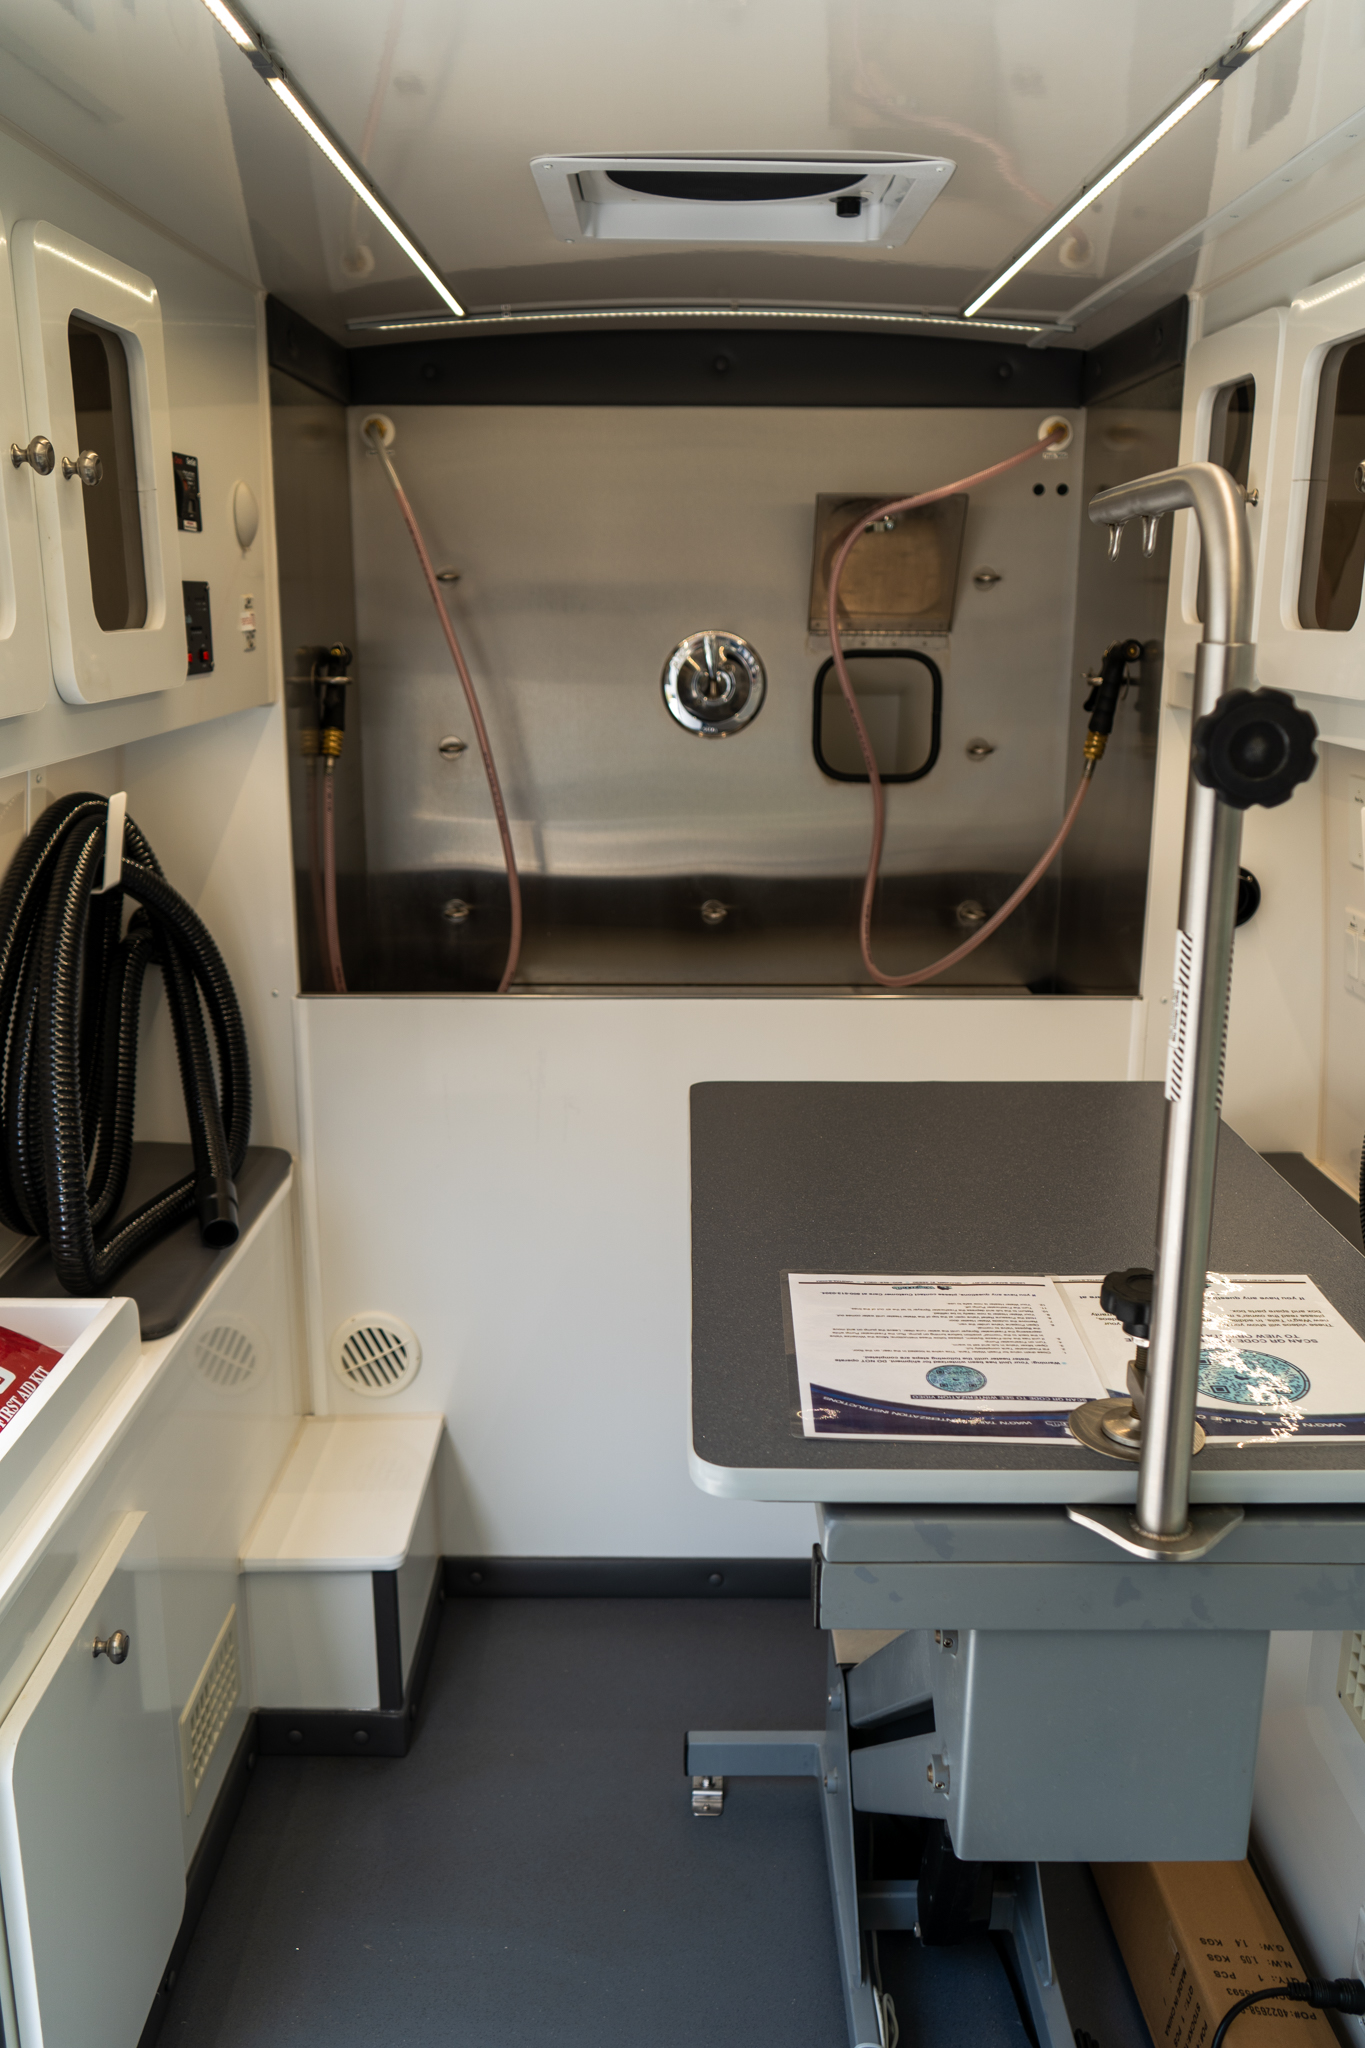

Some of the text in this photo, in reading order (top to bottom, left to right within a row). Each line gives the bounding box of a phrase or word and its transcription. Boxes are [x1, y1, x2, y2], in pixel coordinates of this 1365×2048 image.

[0, 1365, 50, 1428] FIRST AID KIT
[823, 1396, 889, 1414] INSTRUCTIONS
[1199, 1938, 1284, 1952] G.W: 1.4 KGS
[1207, 1954, 1292, 1968] N.W: 1.05 KGS
